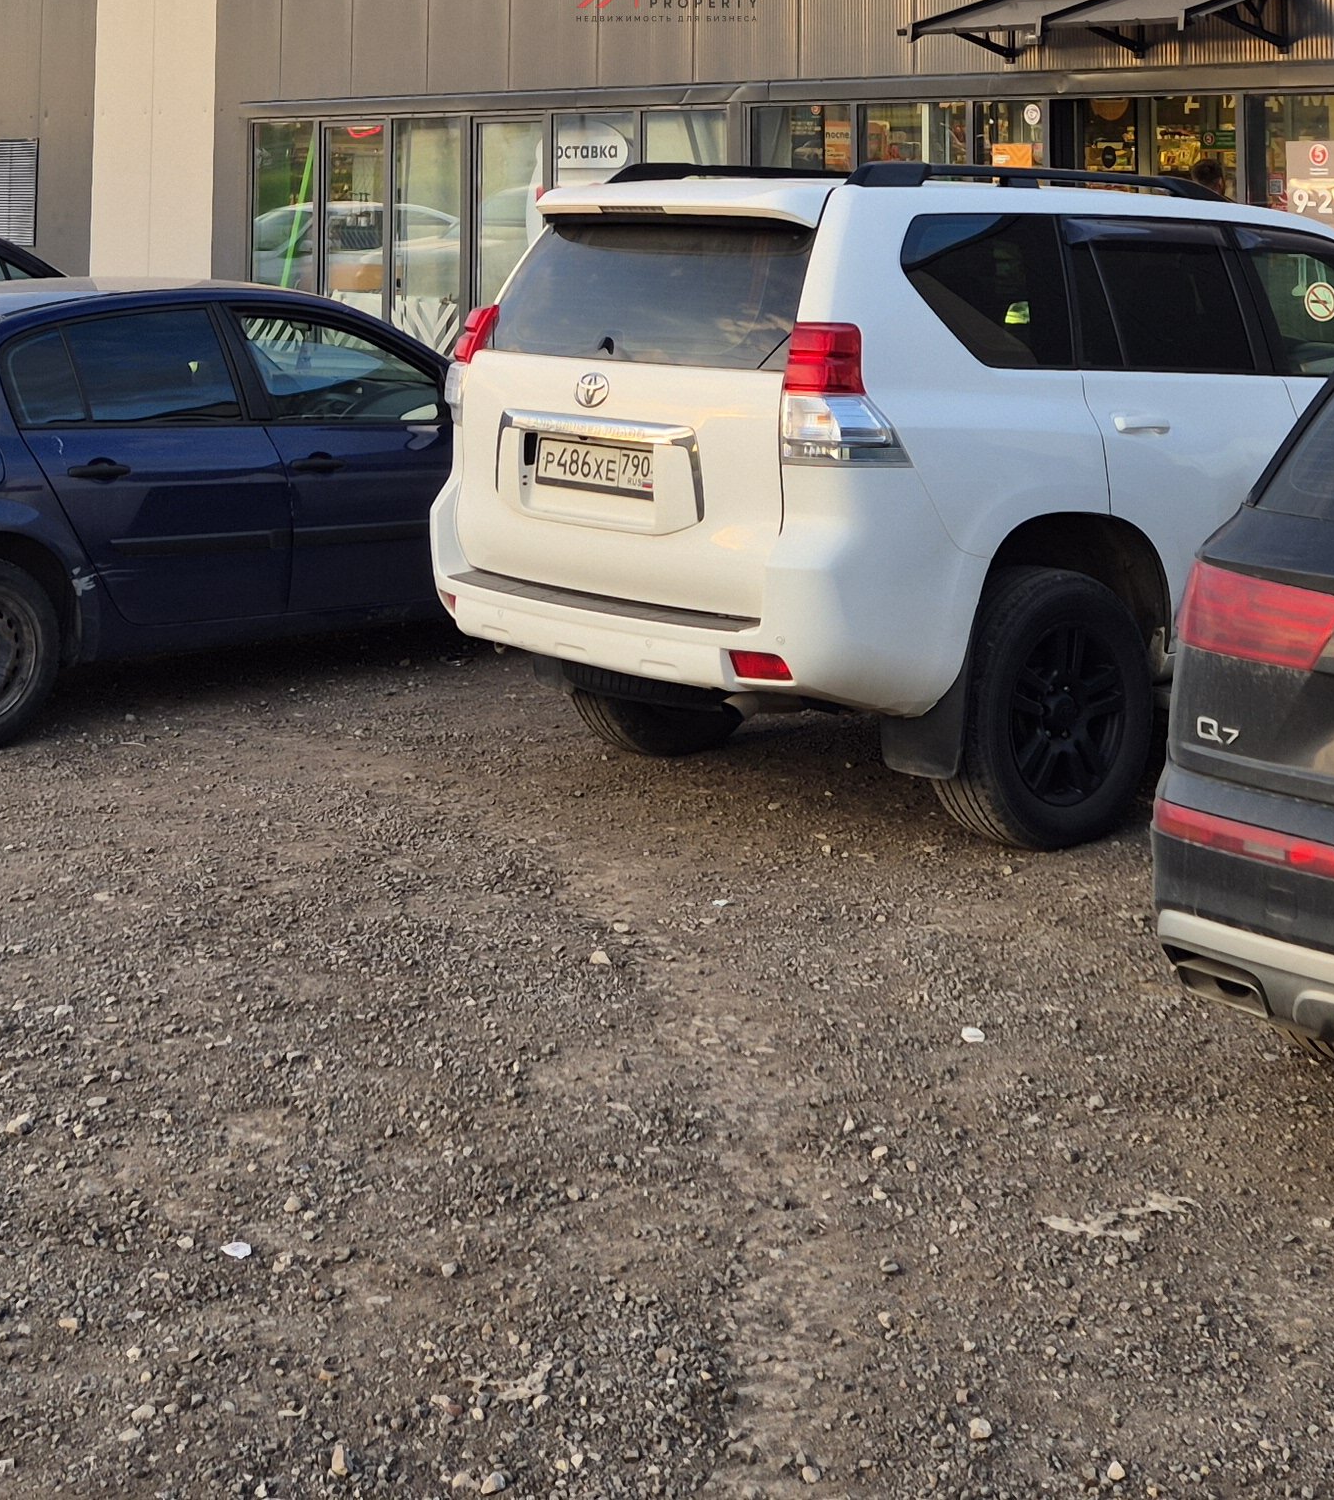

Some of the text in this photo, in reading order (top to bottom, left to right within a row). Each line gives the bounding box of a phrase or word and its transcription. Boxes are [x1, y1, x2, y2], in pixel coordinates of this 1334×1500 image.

[557, 145, 618, 159] оставка
[621, 453, 650, 478] 790
[1197, 716, 1240, 745] Q7
